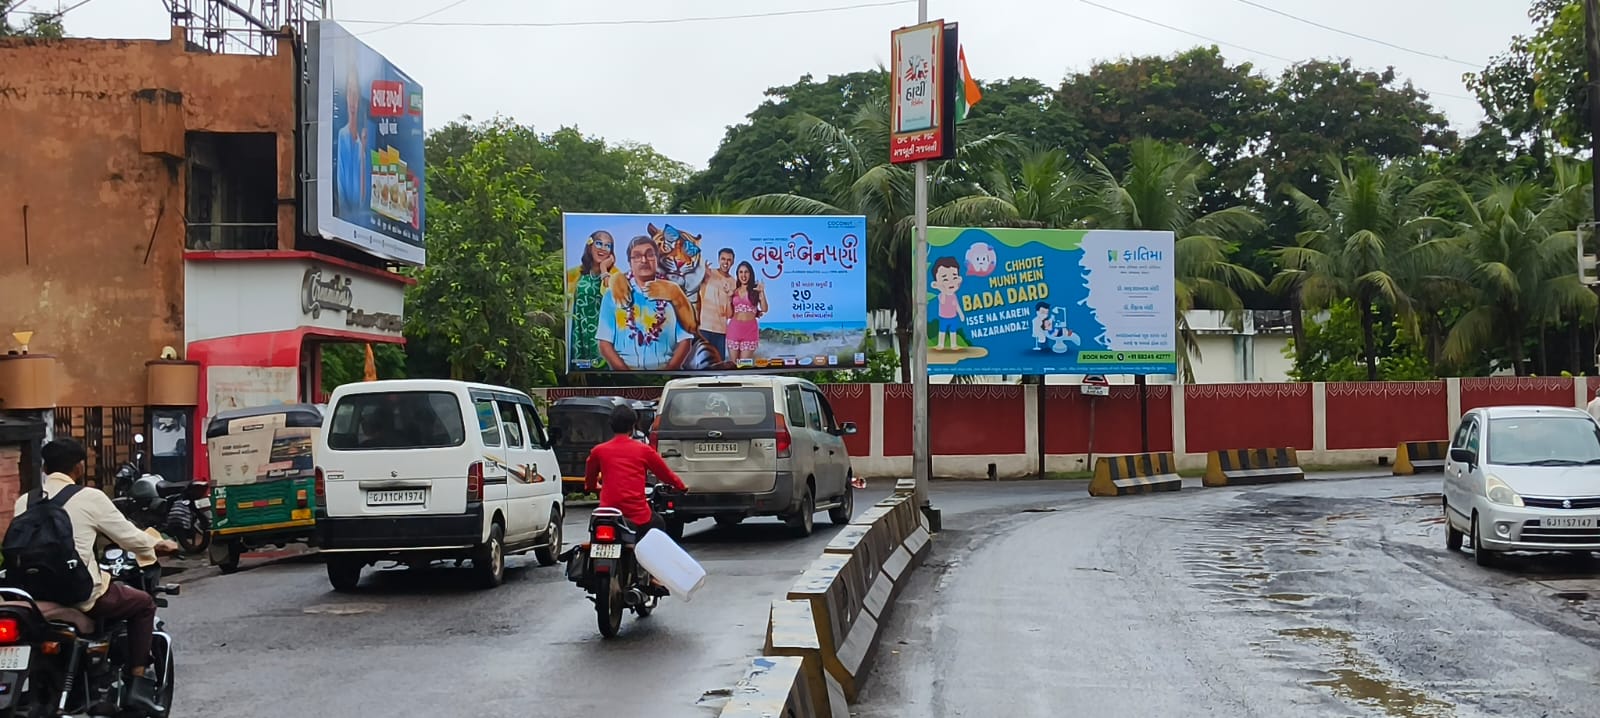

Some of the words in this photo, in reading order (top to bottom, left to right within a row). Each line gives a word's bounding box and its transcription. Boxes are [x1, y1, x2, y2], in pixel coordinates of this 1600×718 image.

[905, 81, 926, 101] હાથી
[1005, 256, 1044, 272] CHHOTE
[989, 273, 1018, 288] MUNH
[1020, 269, 1044, 283] MEIN
[962, 290, 1005, 312] BADA
[1007, 282, 1049, 304] DARD
[966, 314, 985, 326] ISSE
[986, 312, 998, 322] NA
[1000, 307, 1030, 321] KAREIN
[971, 320, 1030, 339] NAZARANDAZ!
